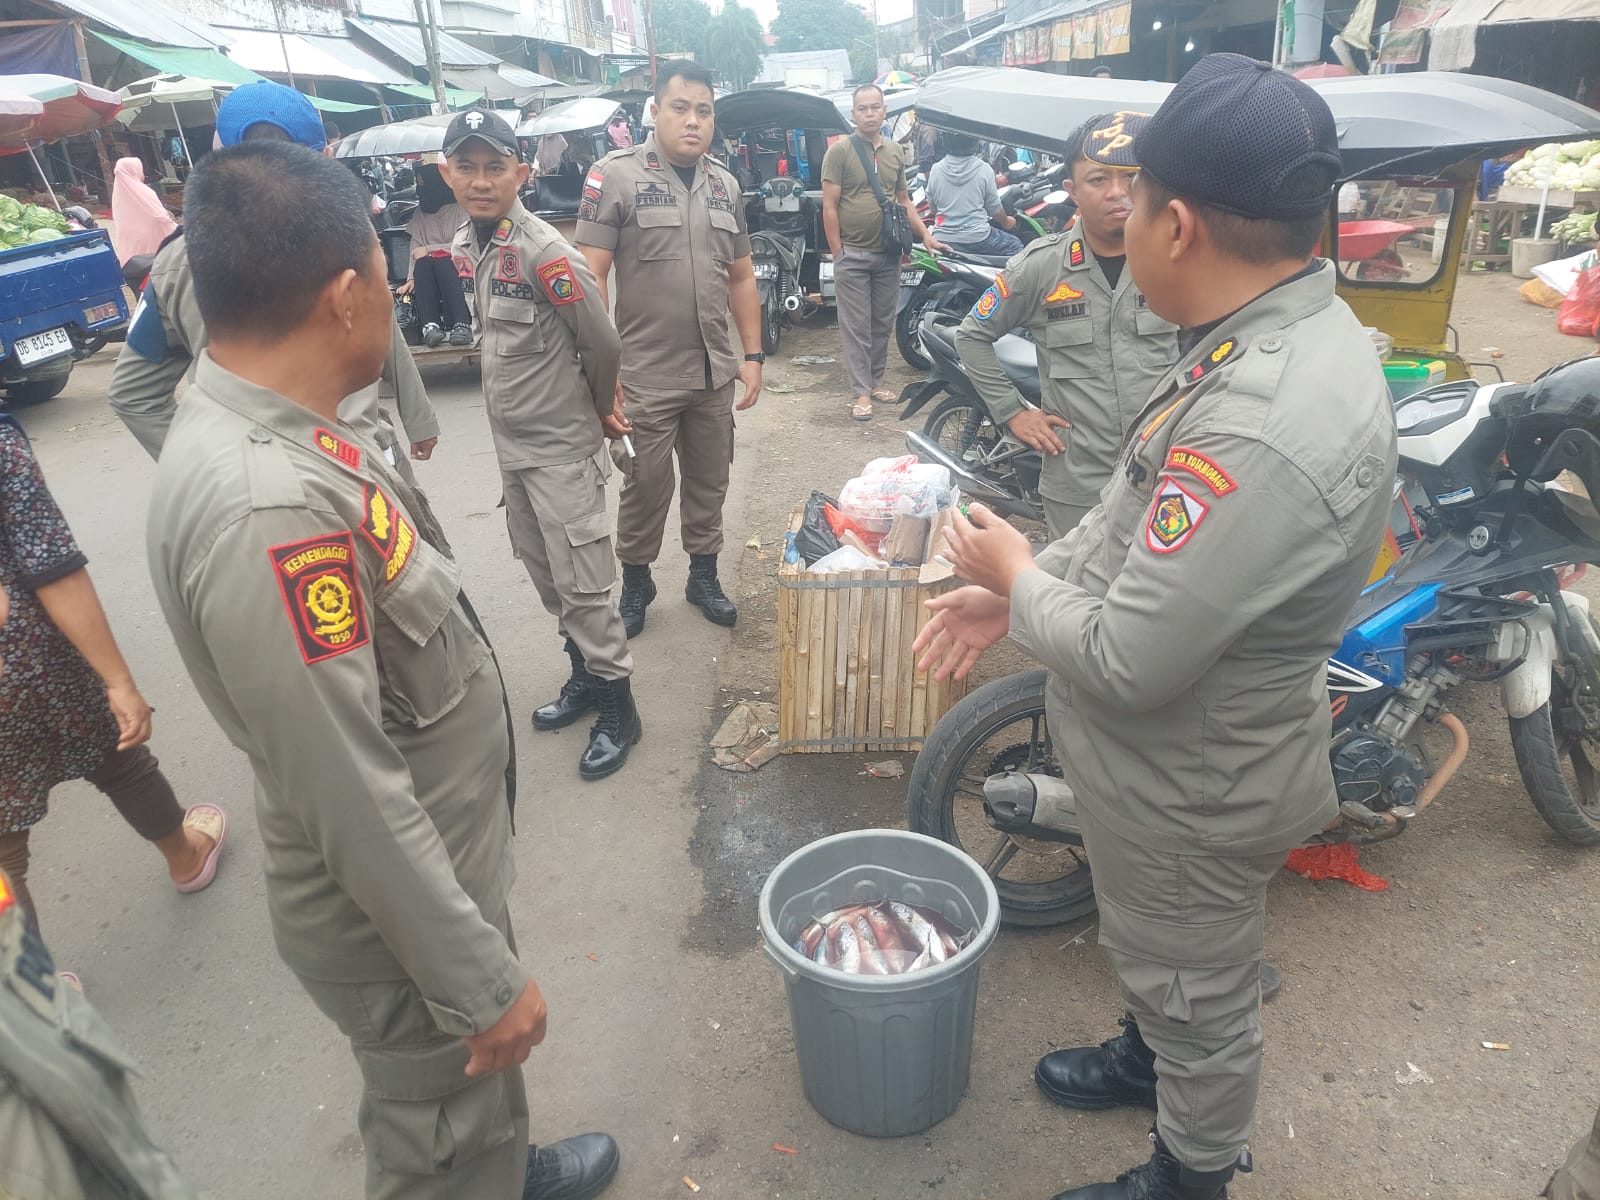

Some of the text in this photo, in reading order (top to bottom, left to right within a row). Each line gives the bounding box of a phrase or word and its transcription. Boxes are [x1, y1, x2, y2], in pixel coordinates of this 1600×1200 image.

[16, 329, 68, 356] DB 8145 EB
[1187, 454, 1230, 491] KOTAMOBAGU
[283, 545, 349, 574] KEMENDAGRI
[329, 631, 351, 644] 1950
